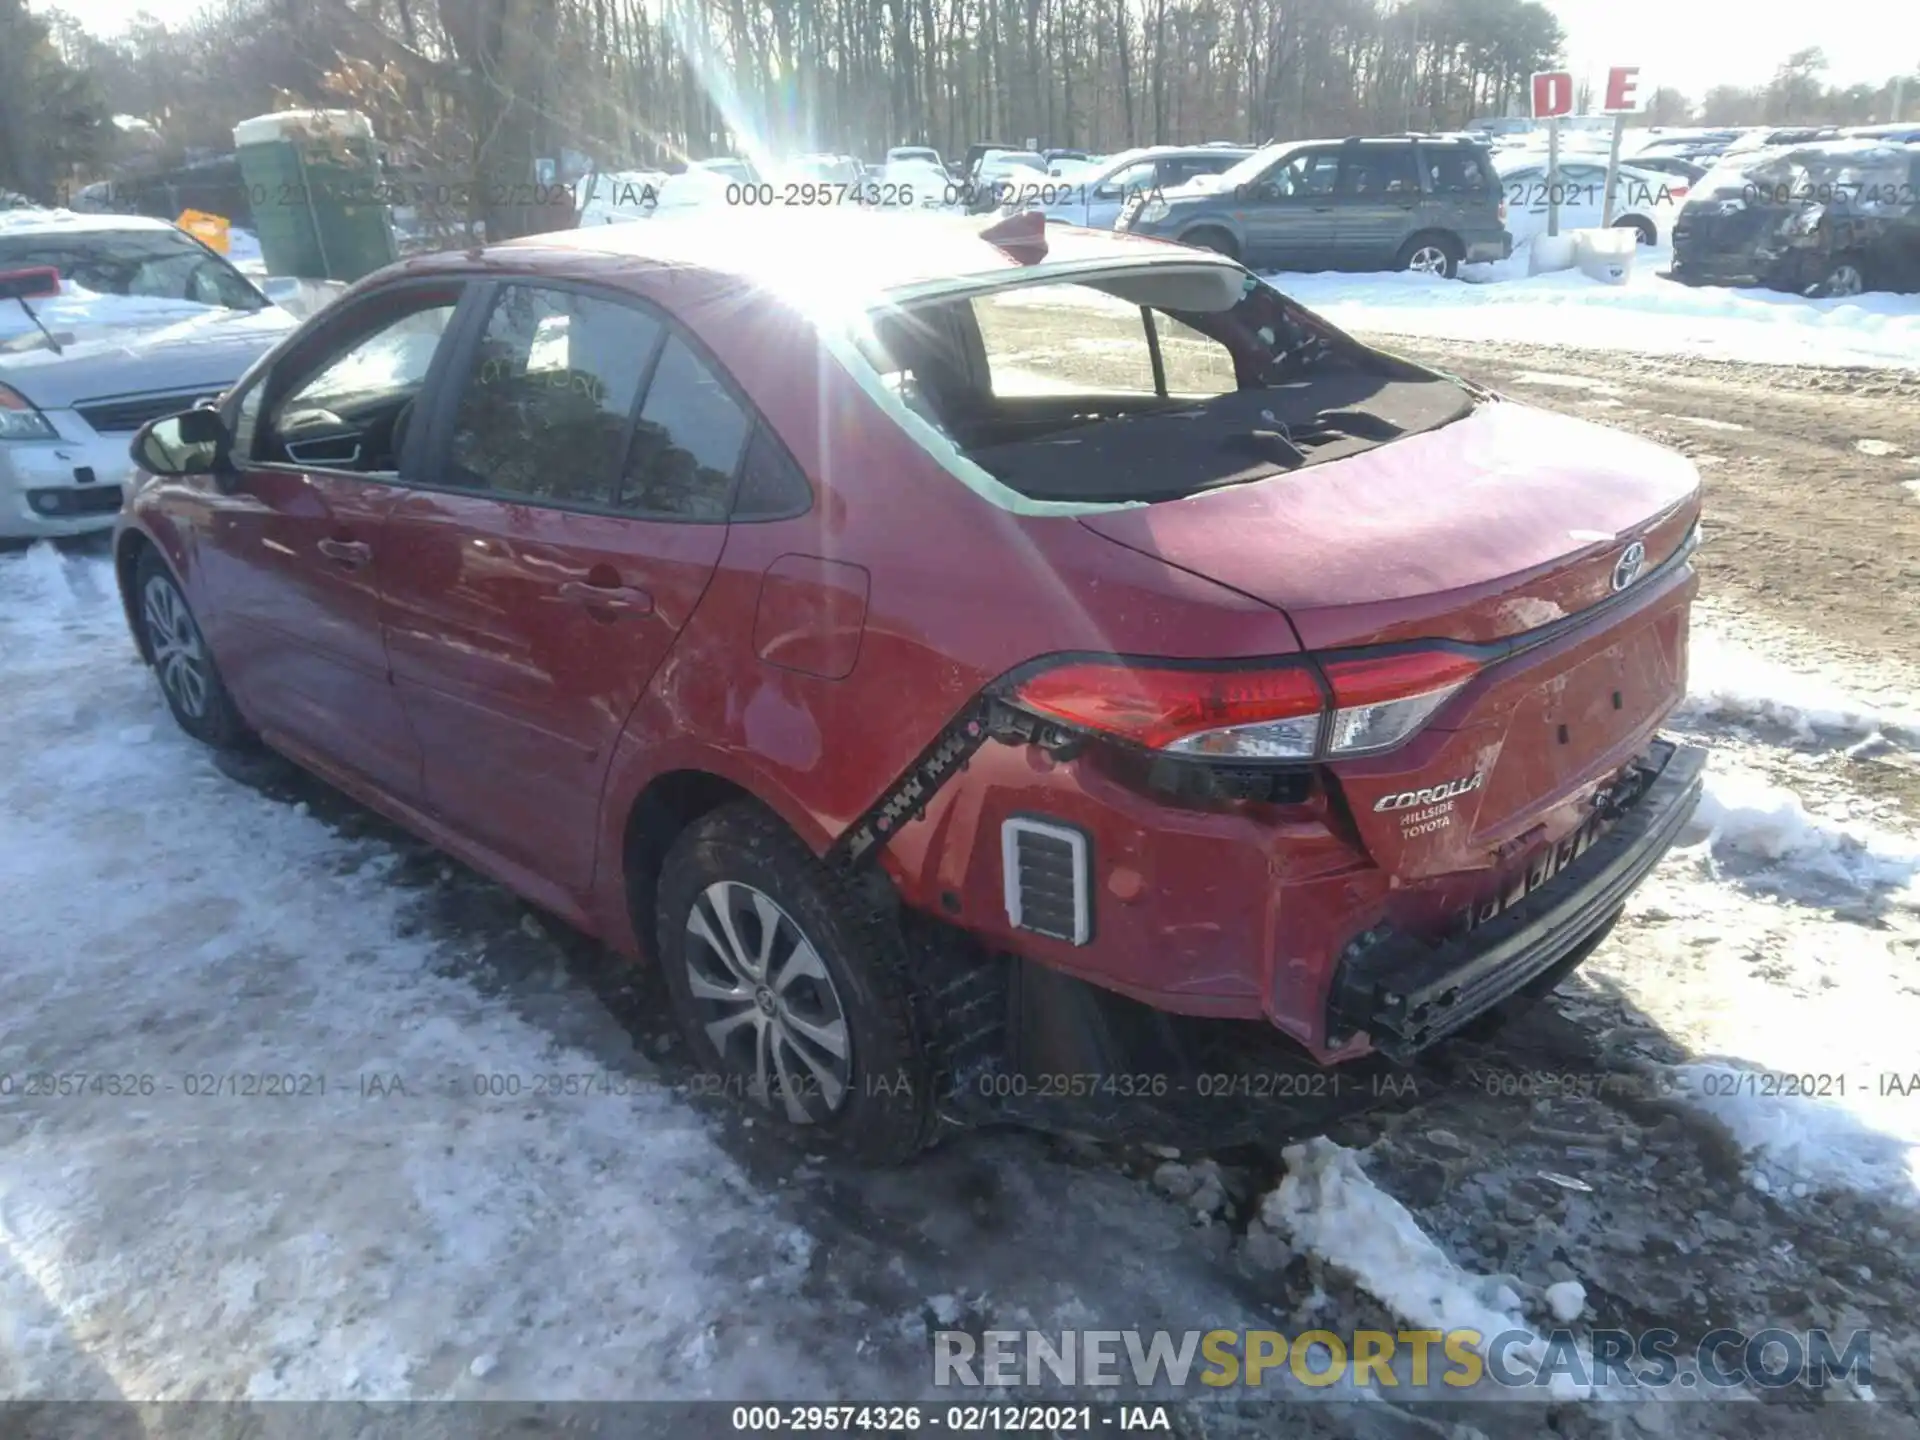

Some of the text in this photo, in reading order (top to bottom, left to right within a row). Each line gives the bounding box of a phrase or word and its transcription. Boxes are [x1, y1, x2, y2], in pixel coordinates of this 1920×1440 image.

[1534, 74, 1572, 117] D
[1605, 67, 1640, 110] E
[1373, 772, 1484, 812] COROLLA
[1400, 800, 1454, 825] HILLSIDE
[1401, 816, 1450, 839] TOYOTA
